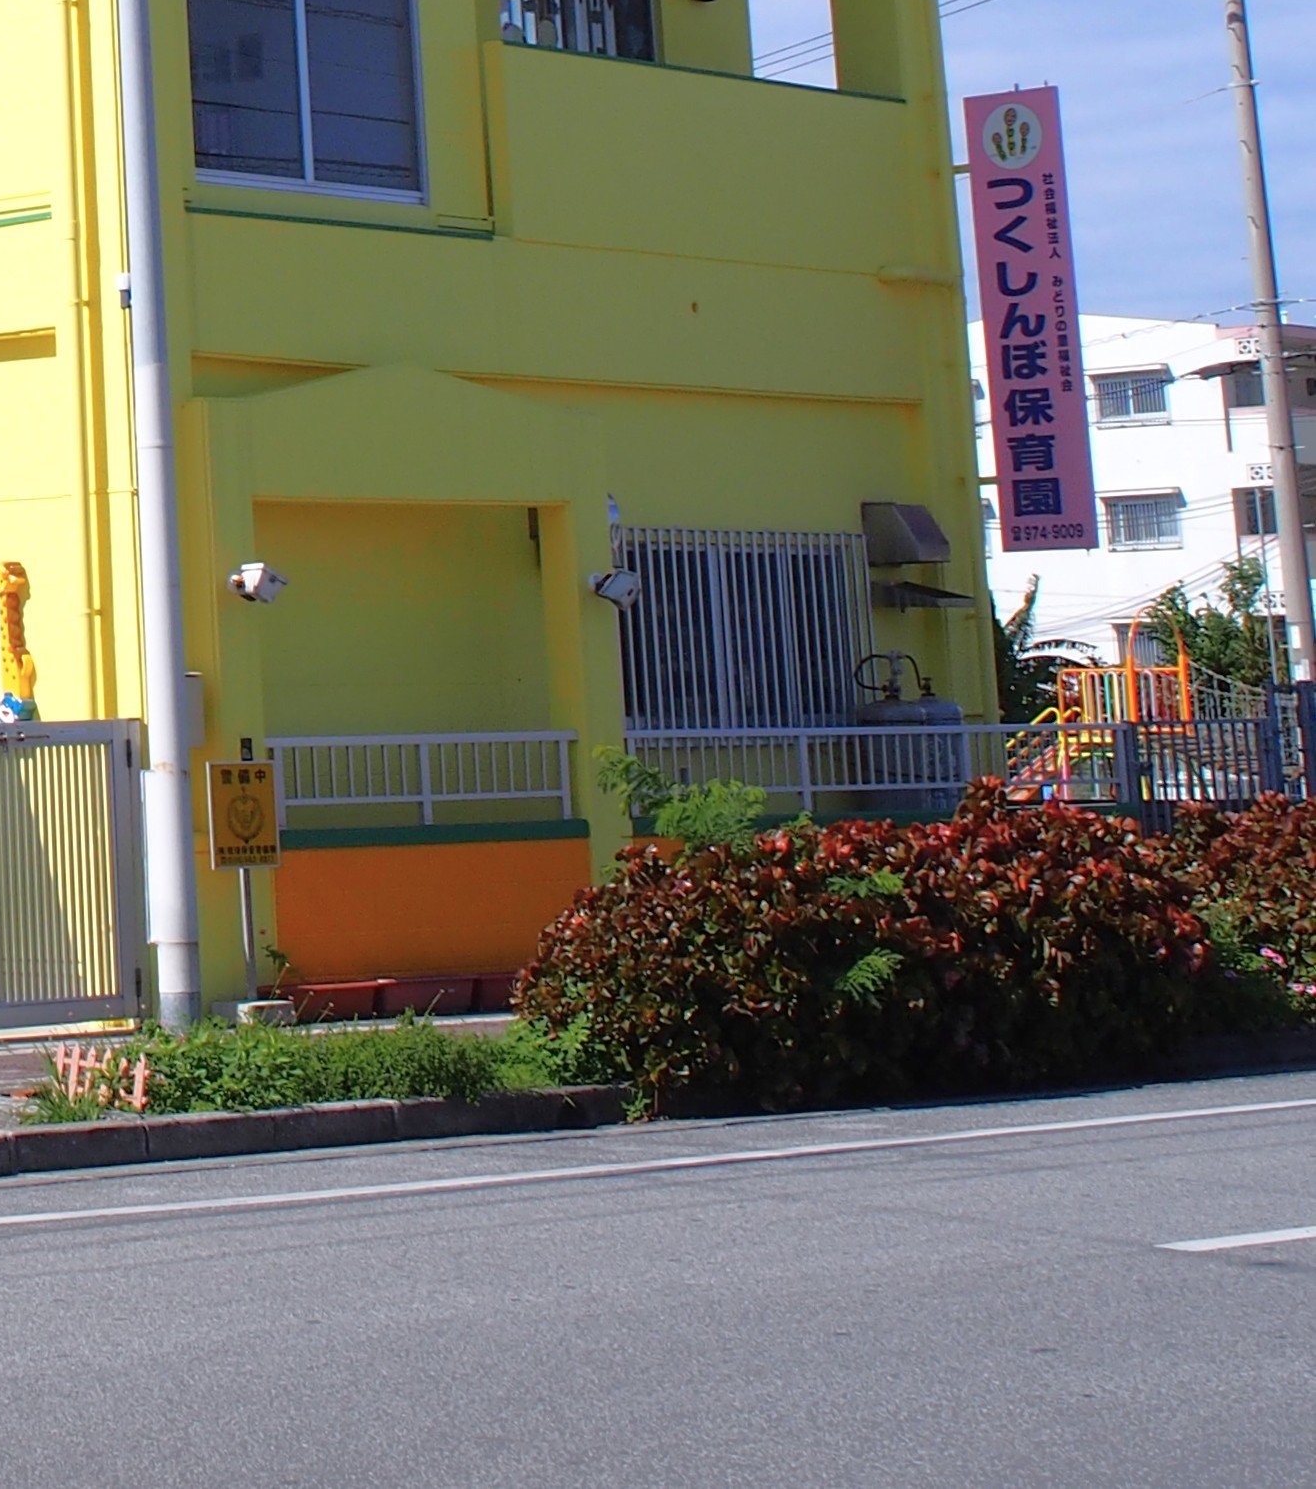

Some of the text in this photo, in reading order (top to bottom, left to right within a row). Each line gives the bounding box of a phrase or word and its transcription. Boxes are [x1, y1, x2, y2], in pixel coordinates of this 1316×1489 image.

[986, 177, 1062, 517] つくしんぼ保育園
